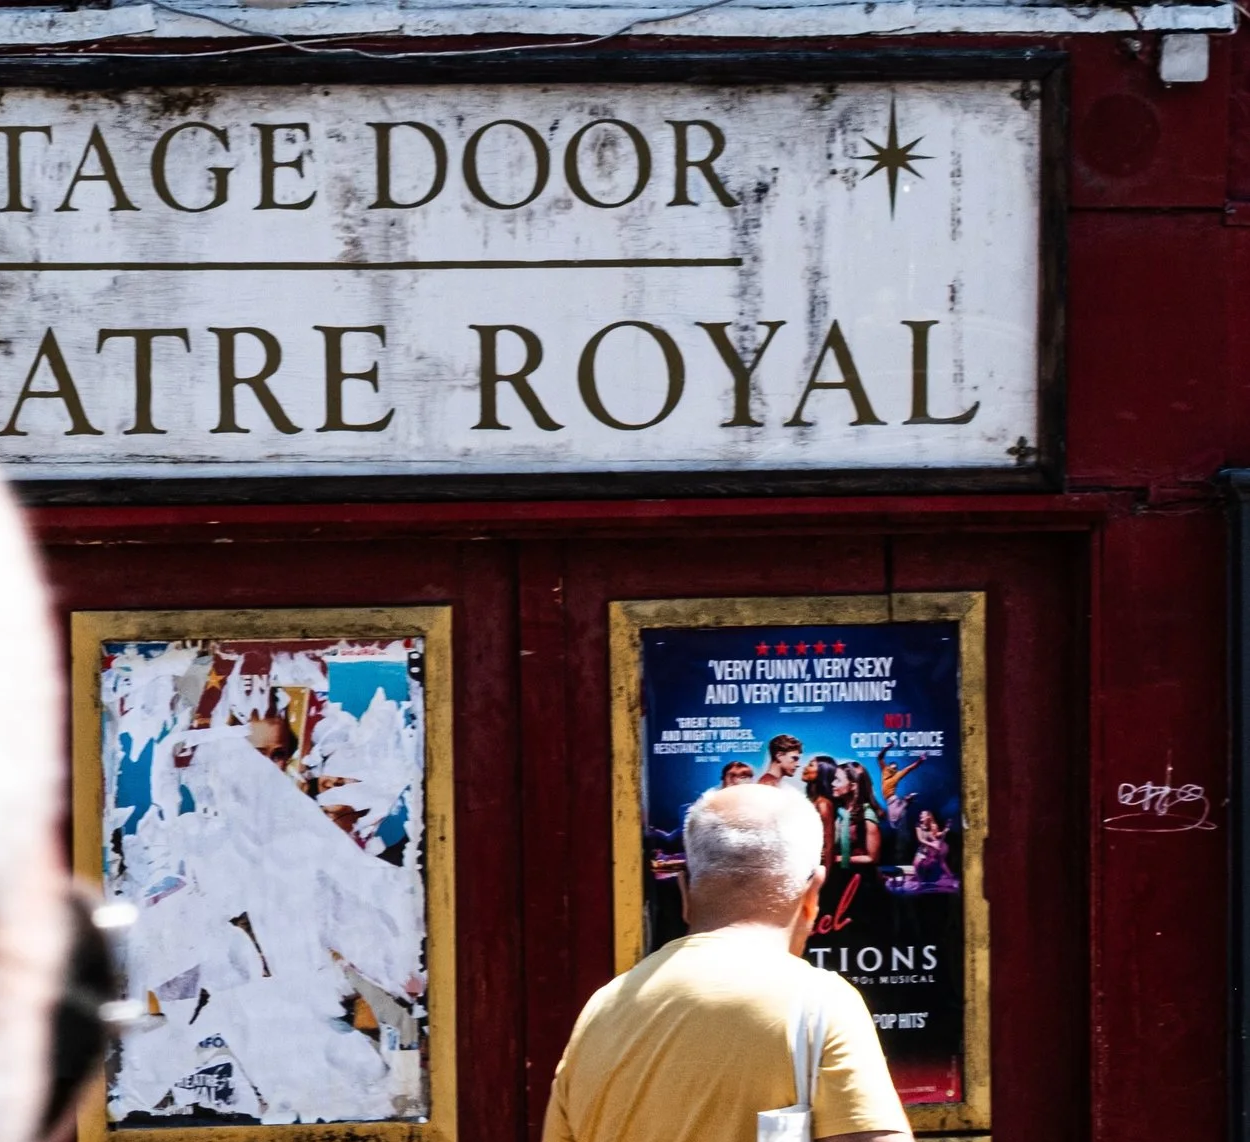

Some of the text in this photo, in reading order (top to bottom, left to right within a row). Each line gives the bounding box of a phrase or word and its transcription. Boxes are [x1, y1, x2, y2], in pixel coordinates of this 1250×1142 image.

[364, 118, 741, 211] DOOR
[467, 318, 981, 432] ROYAL
[755, 658, 812, 683] FUNNY,
[812, 657, 852, 680] VERY
[854, 656, 894, 679] SEXY
[704, 683, 740, 705] AND
[741, 683, 782, 704] VERY
[661, 730, 681, 741] AND
[899, 730, 944, 747] CHOICE
[653, 742, 704, 754] RESISTANCE
[809, 945, 938, 972] TIONS
[878, 974, 936, 985] MUSICAL
